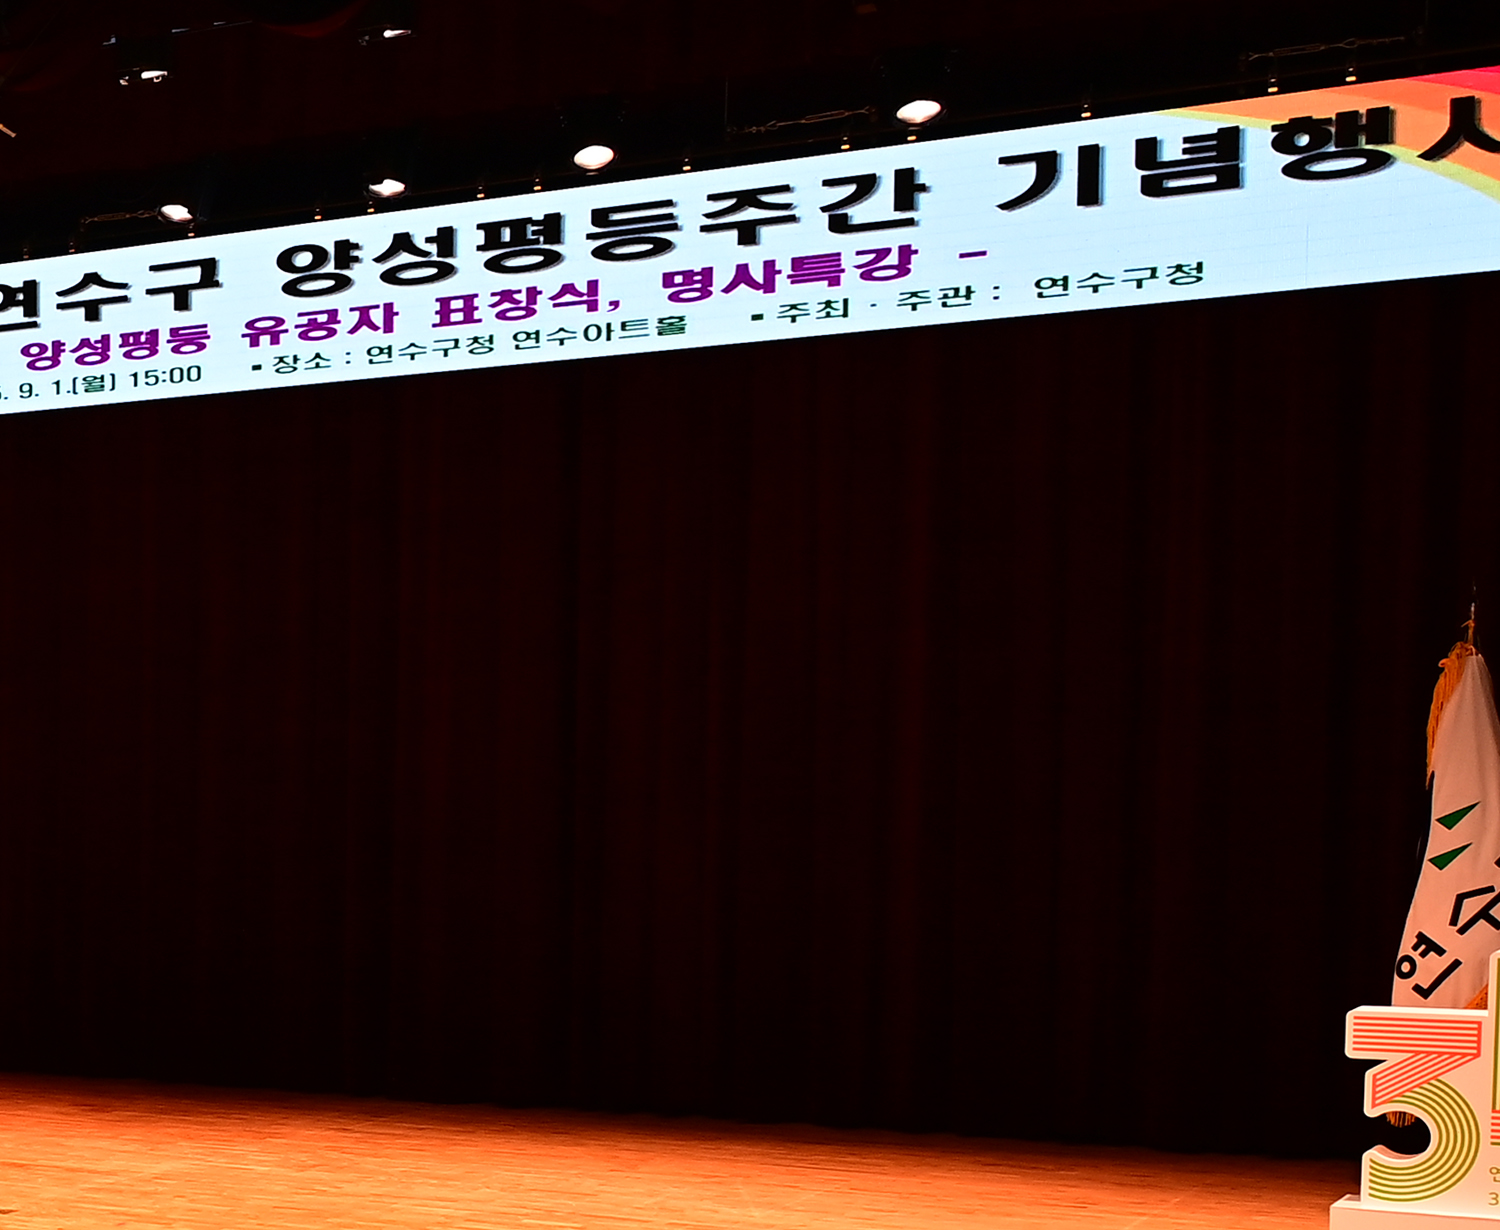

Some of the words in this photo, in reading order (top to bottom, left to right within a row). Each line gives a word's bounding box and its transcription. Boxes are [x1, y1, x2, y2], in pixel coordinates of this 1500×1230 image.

[276, 166, 930, 298] 양성평등주간
[19, 323, 212, 372] 양성평등
[241, 302, 400, 348] 유공자
[661, 243, 919, 303] 명사특강
[775, 297, 850, 325] 주최
[895, 284, 976, 313] 주관
[1033, 260, 1205, 300] 연수구청
[18, 382, 40, 399] 9.
[128, 364, 202, 388] 15:00
[272, 352, 332, 375] 장소
[366, 333, 496, 366] 연수구청
[511, 315, 688, 351] 연수아트홀
[1395, 857, 1500, 1001] 연수
